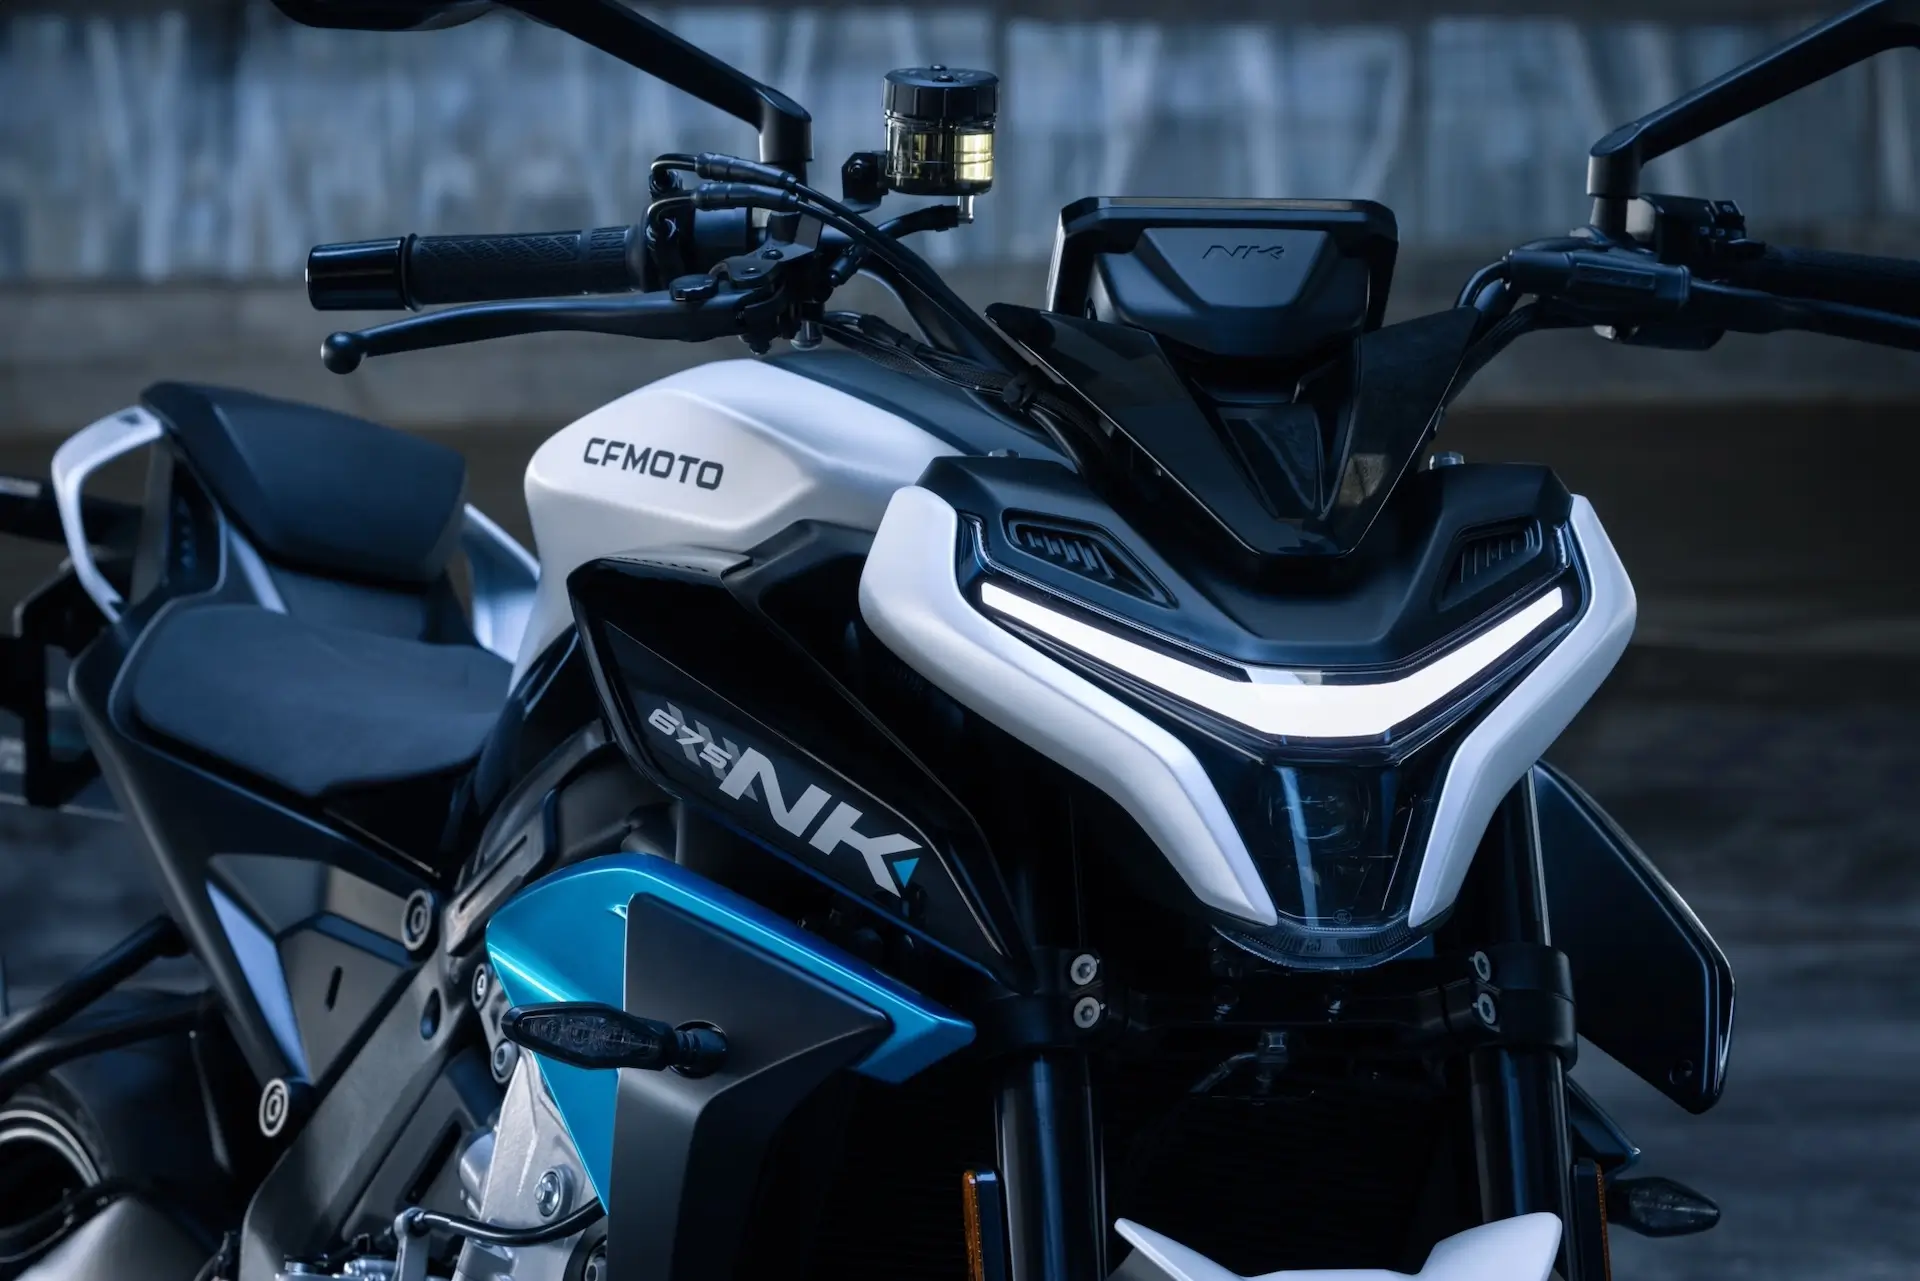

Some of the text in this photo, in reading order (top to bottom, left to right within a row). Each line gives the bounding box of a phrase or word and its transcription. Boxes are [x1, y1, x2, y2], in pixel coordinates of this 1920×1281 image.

[1202, 245, 1285, 260] NK
[583, 437, 724, 491] CFMOTO
[648, 708, 923, 898] 675 NK
